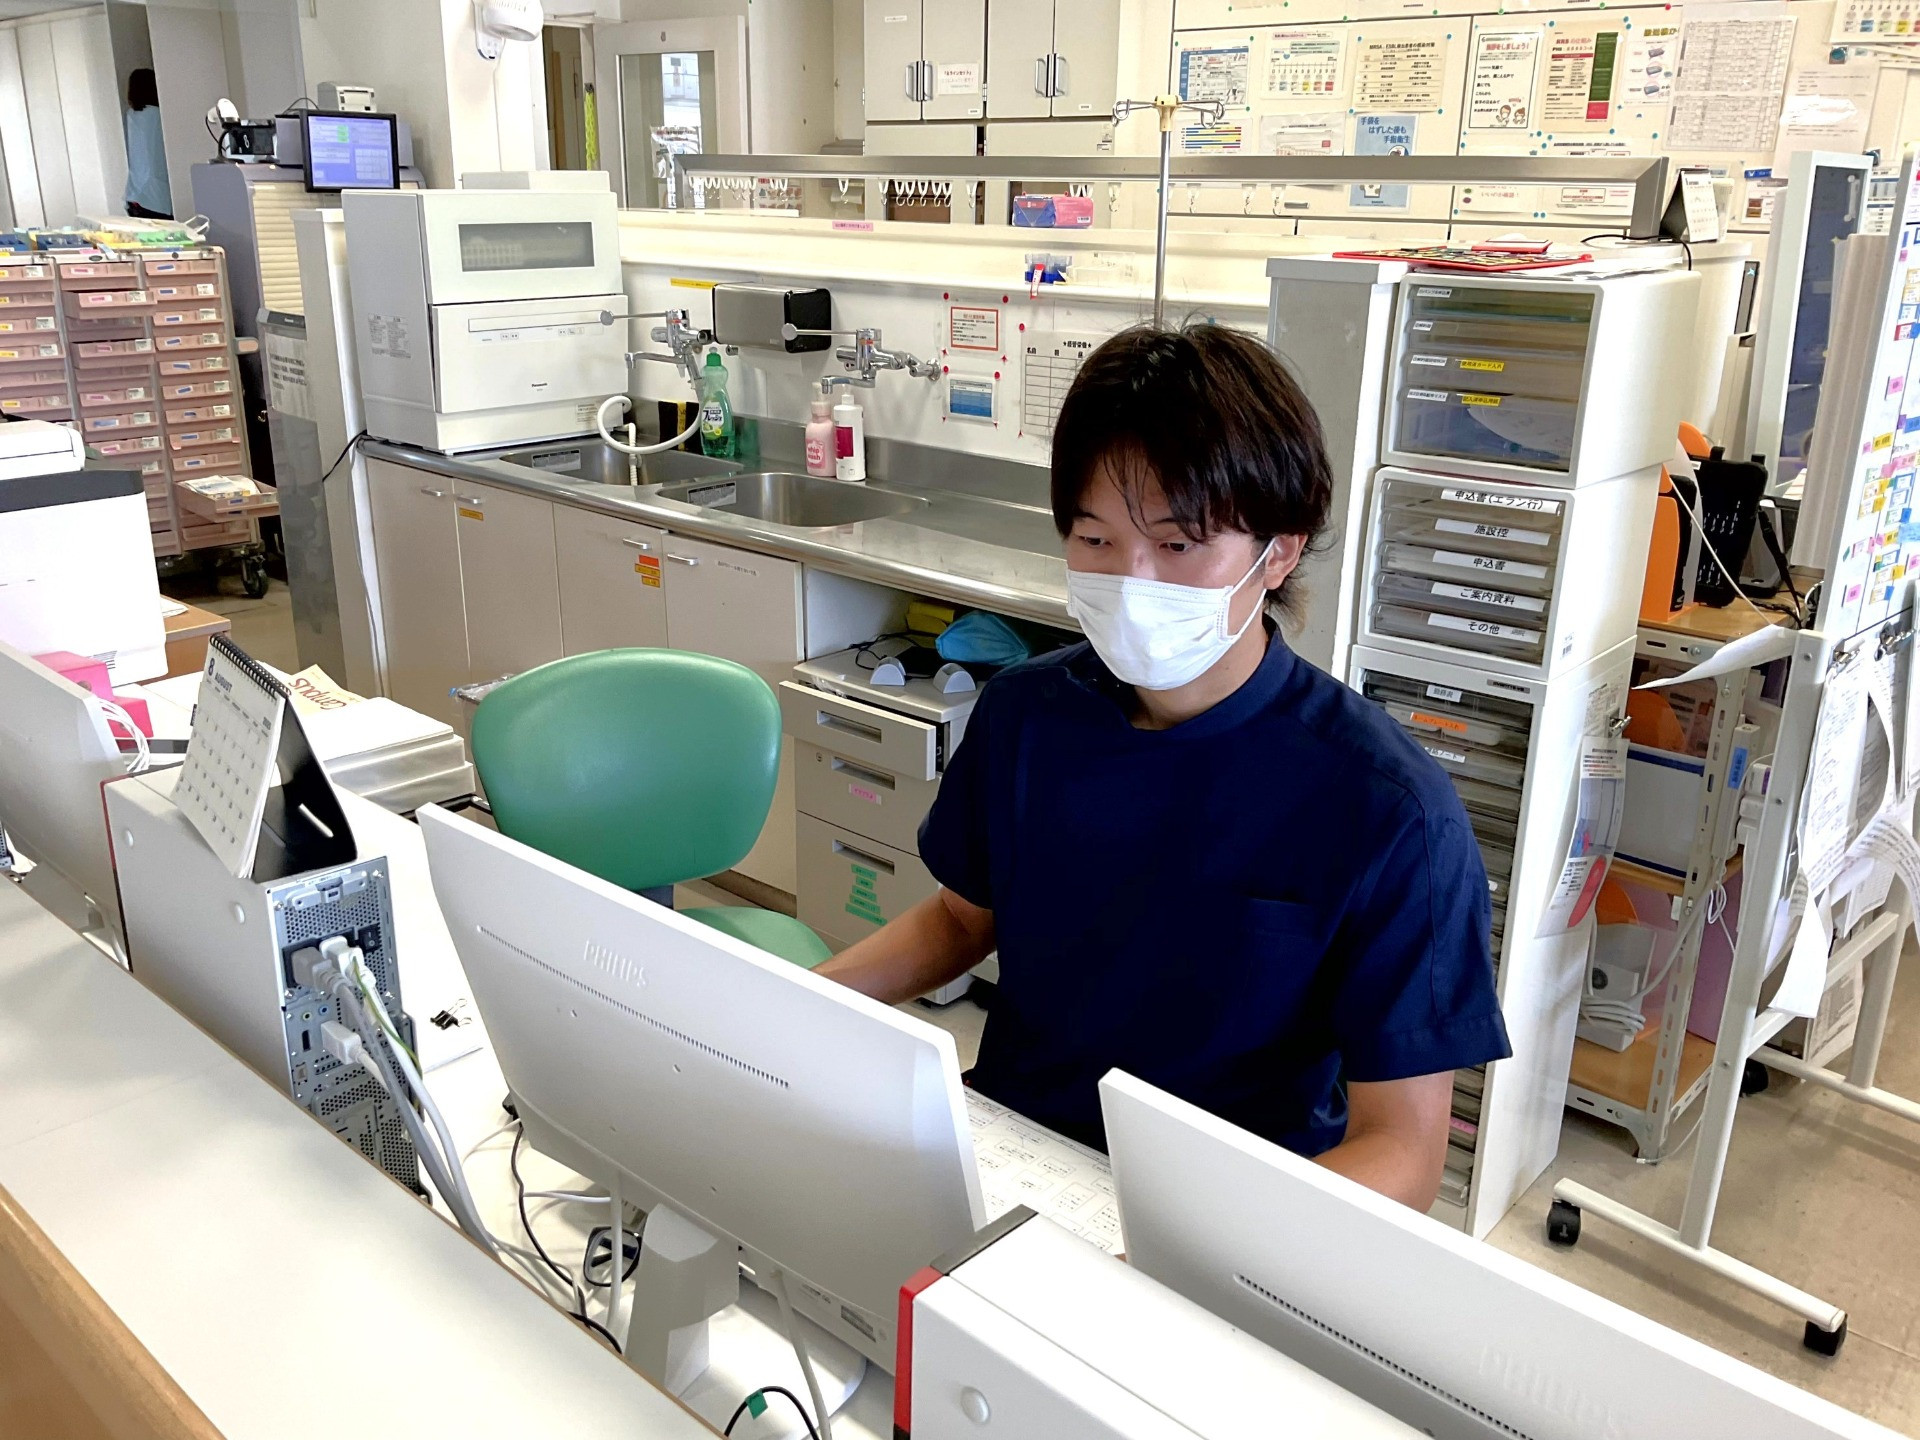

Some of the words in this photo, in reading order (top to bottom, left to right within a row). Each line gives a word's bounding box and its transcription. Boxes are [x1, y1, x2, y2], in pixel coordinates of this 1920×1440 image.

[1368, 125, 1407, 134] はずした後も
[1474, 525, 1509, 538] 施設控
[1473, 557, 1505, 571] 申込書
[1460, 588, 1515, 606] ご案内資料
[1468, 621, 1500, 635] その他
[208, 657, 216, 677] 8
[215, 672, 233, 693] AUGUST
[287, 677, 347, 711] Campus
[583, 939, 647, 987] PHILIPS
